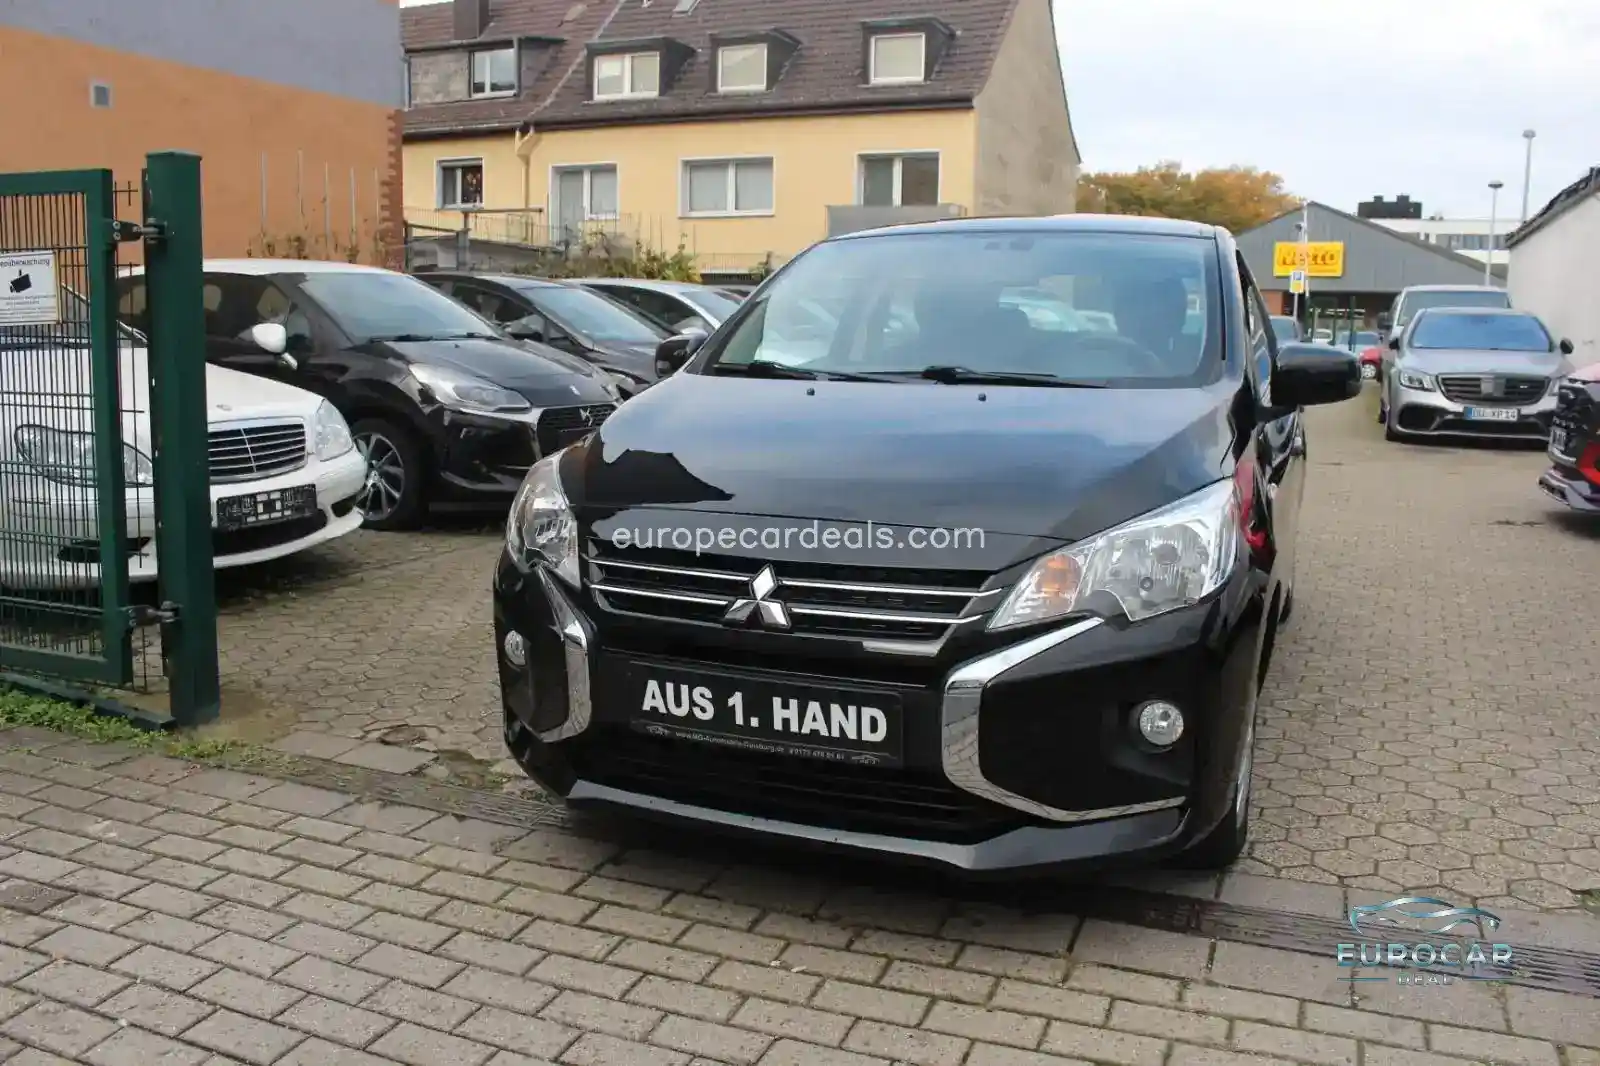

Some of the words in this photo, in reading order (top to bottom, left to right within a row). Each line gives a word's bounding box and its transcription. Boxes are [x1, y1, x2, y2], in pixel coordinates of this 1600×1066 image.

[642, 679, 715, 721] AUS
[727, 691, 760, 728] 1.
[772, 696, 888, 742] HAND
